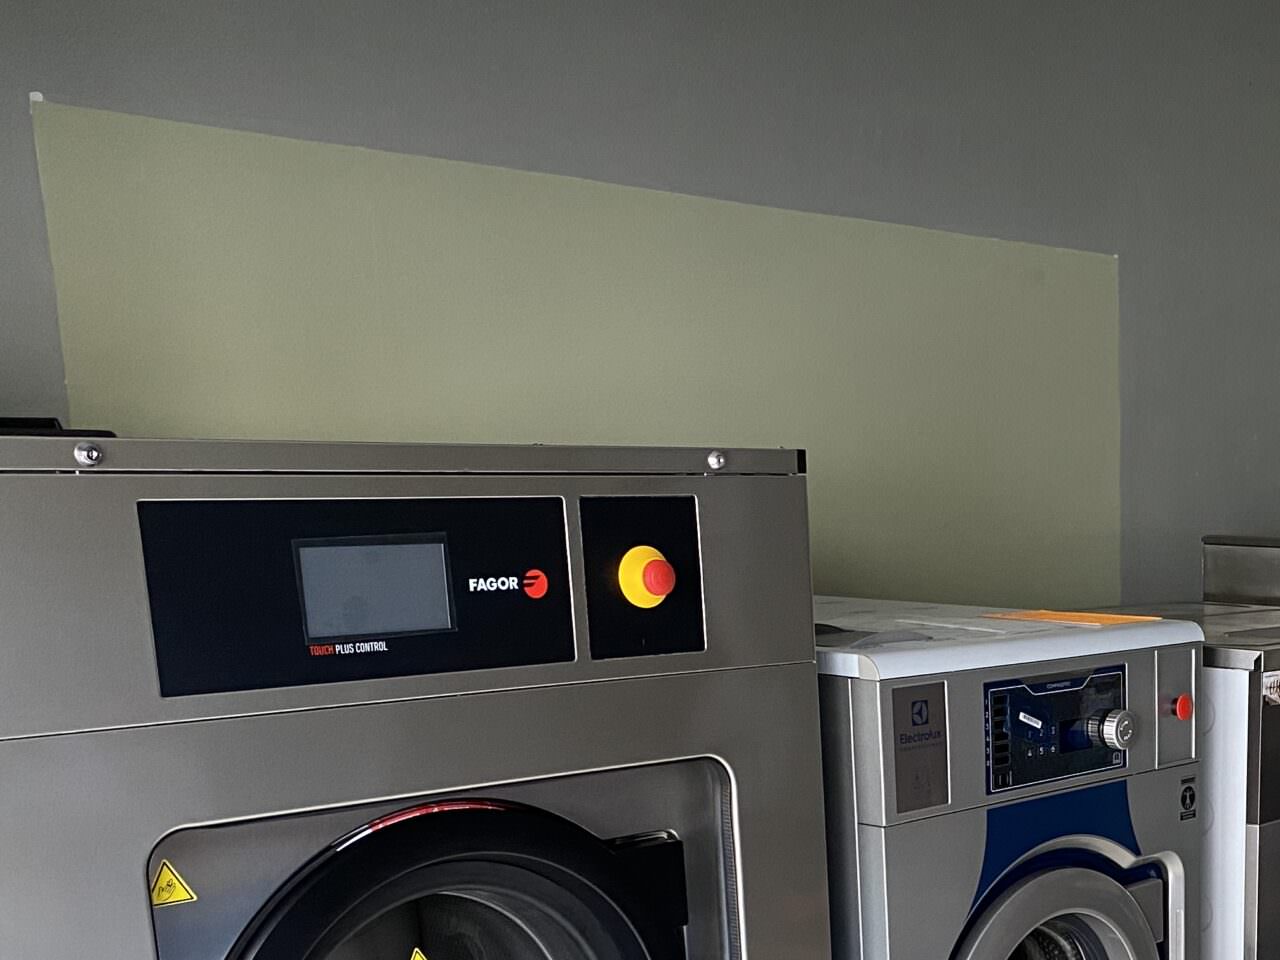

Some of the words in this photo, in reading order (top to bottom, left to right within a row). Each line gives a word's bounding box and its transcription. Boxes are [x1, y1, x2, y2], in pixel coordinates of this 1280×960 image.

[468, 576, 519, 592] FAGOR
[309, 644, 334, 656] TOUCH
[335, 643, 354, 655] PLUS
[355, 641, 388, 653] CONTROL
